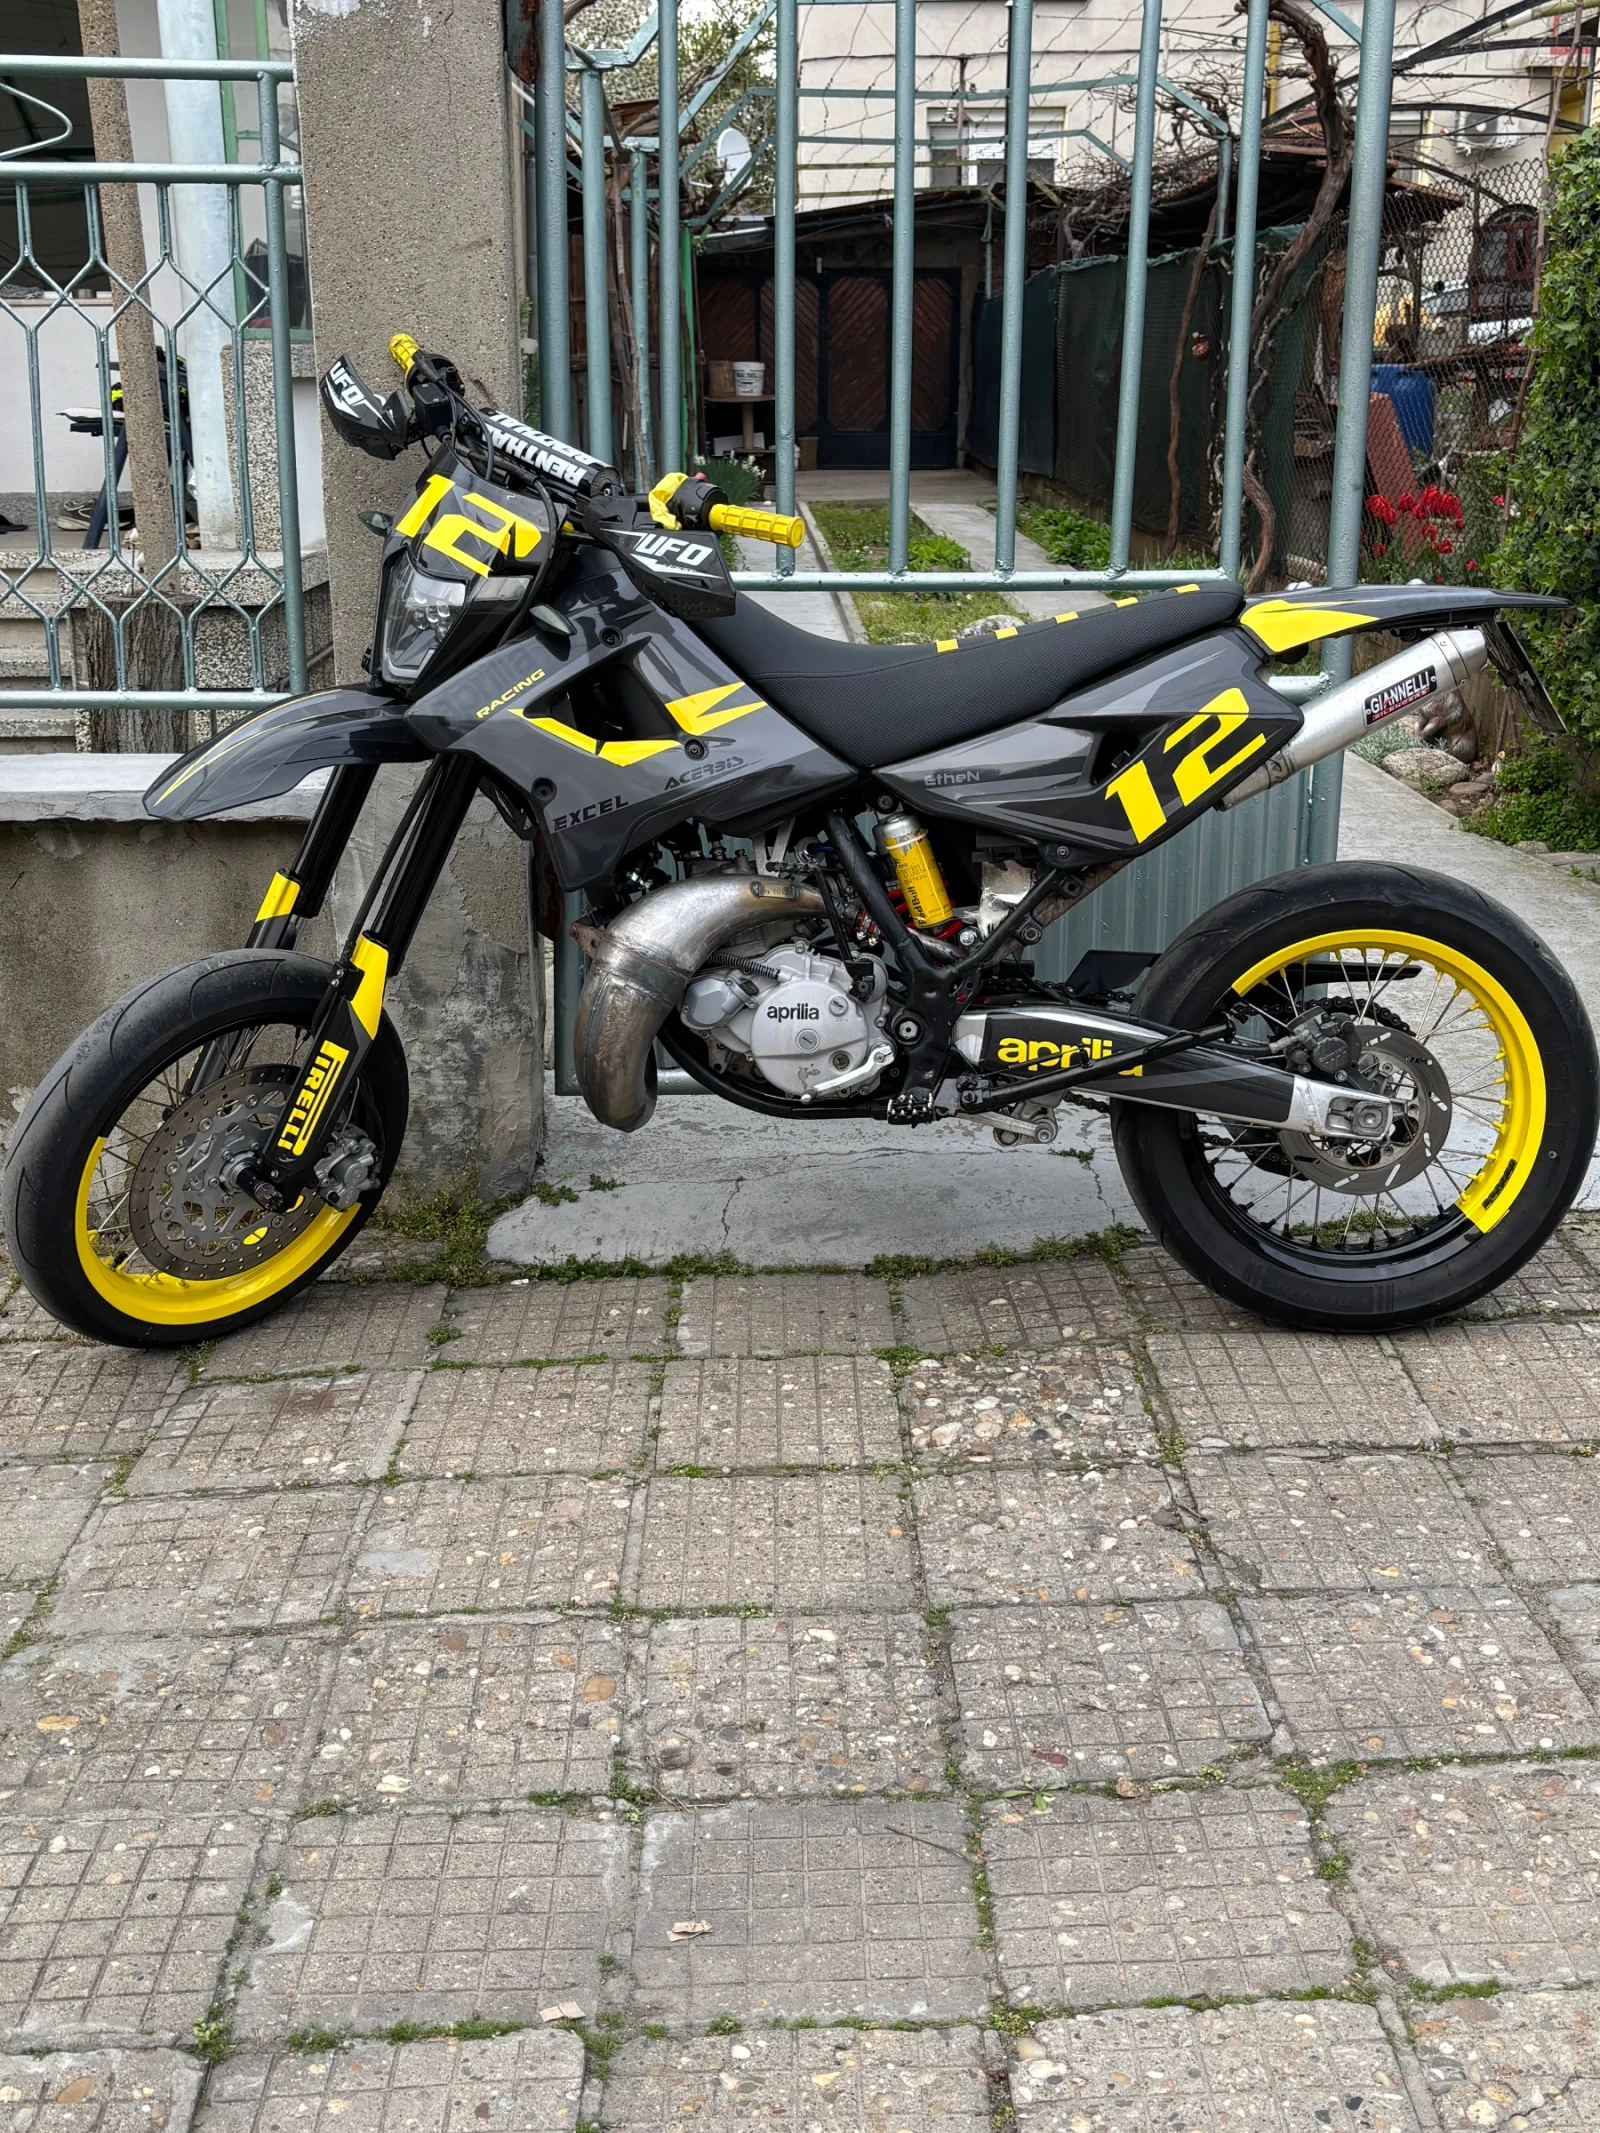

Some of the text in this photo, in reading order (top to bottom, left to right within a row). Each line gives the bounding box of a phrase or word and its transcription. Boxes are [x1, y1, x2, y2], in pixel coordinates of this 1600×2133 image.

[329, 361, 366, 405] UFO
[481, 421, 588, 487] RENTHAL
[395, 474, 542, 579] 12
[635, 533, 713, 566] UFO
[476, 668, 546, 719] RACING
[1370, 671, 1430, 714] GIANNELLI
[1104, 687, 1267, 844] 12
[552, 795, 629, 832] EXCEL
[766, 1003, 820, 1023] aprilia
[997, 1037, 1144, 1078] aprili
[277, 1039, 350, 1156] PIRELLI
